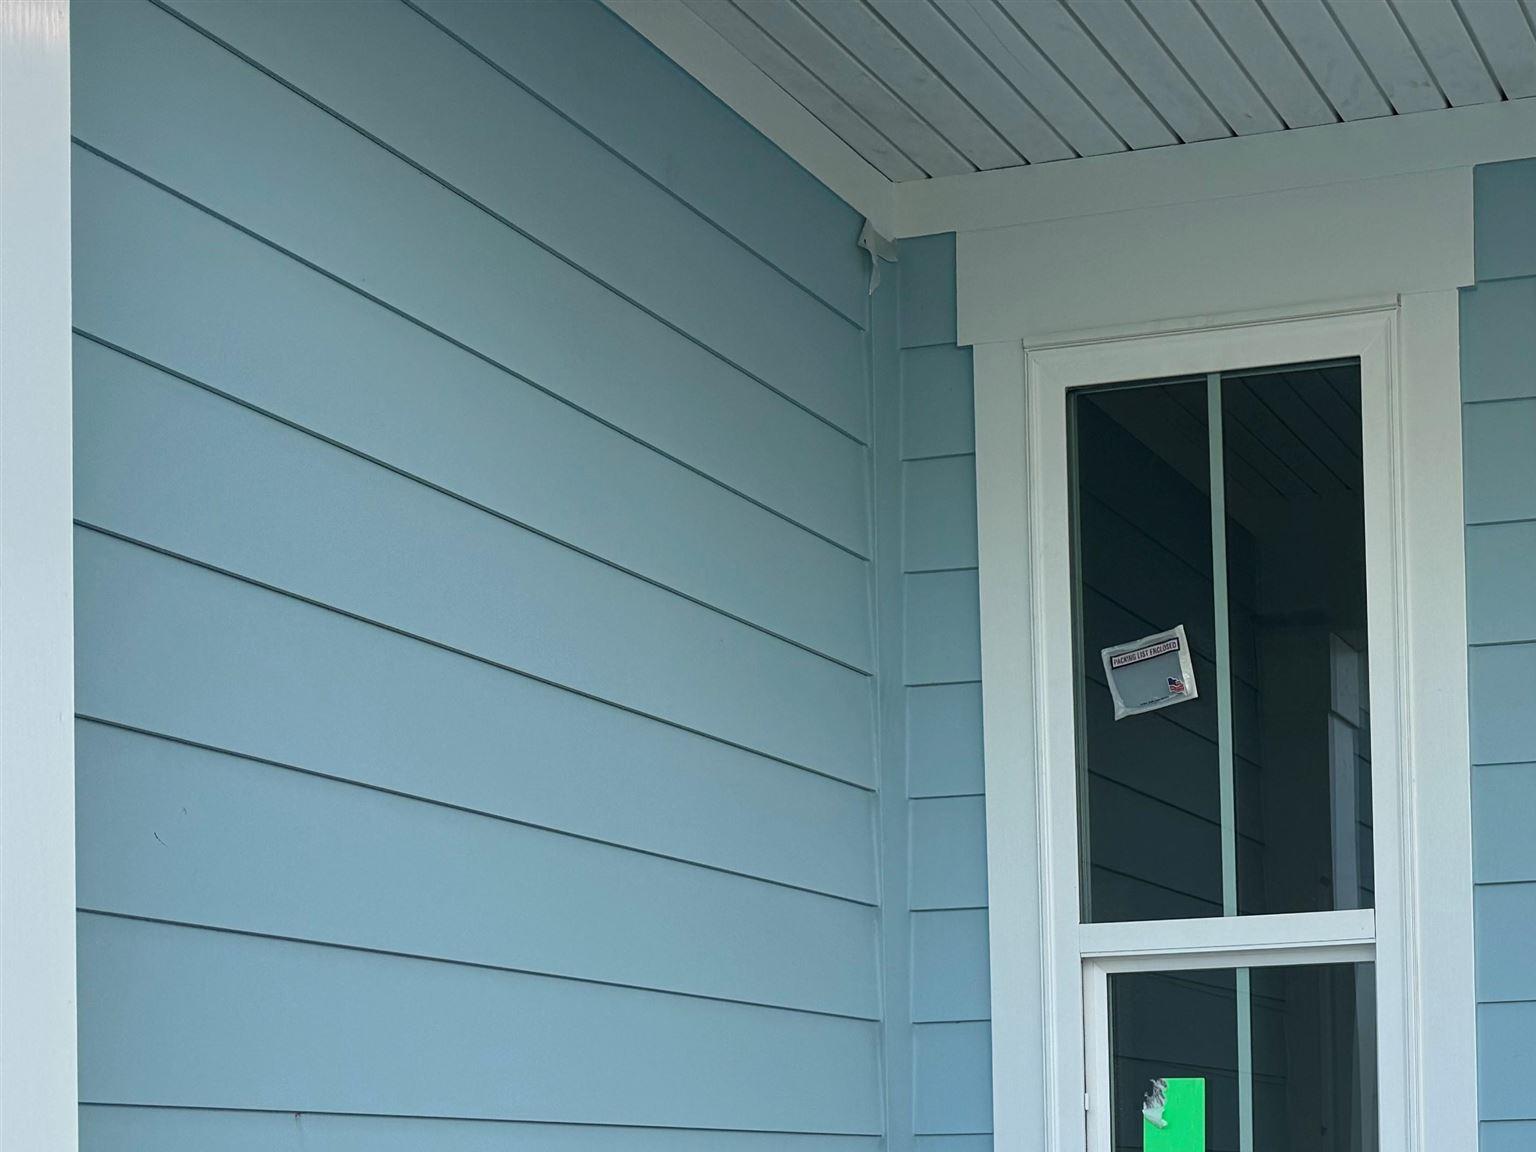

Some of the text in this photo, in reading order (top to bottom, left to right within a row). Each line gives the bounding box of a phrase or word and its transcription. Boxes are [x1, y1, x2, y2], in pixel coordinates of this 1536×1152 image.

[1113, 641, 1176, 665] PACKING LIST ENCLOSED
